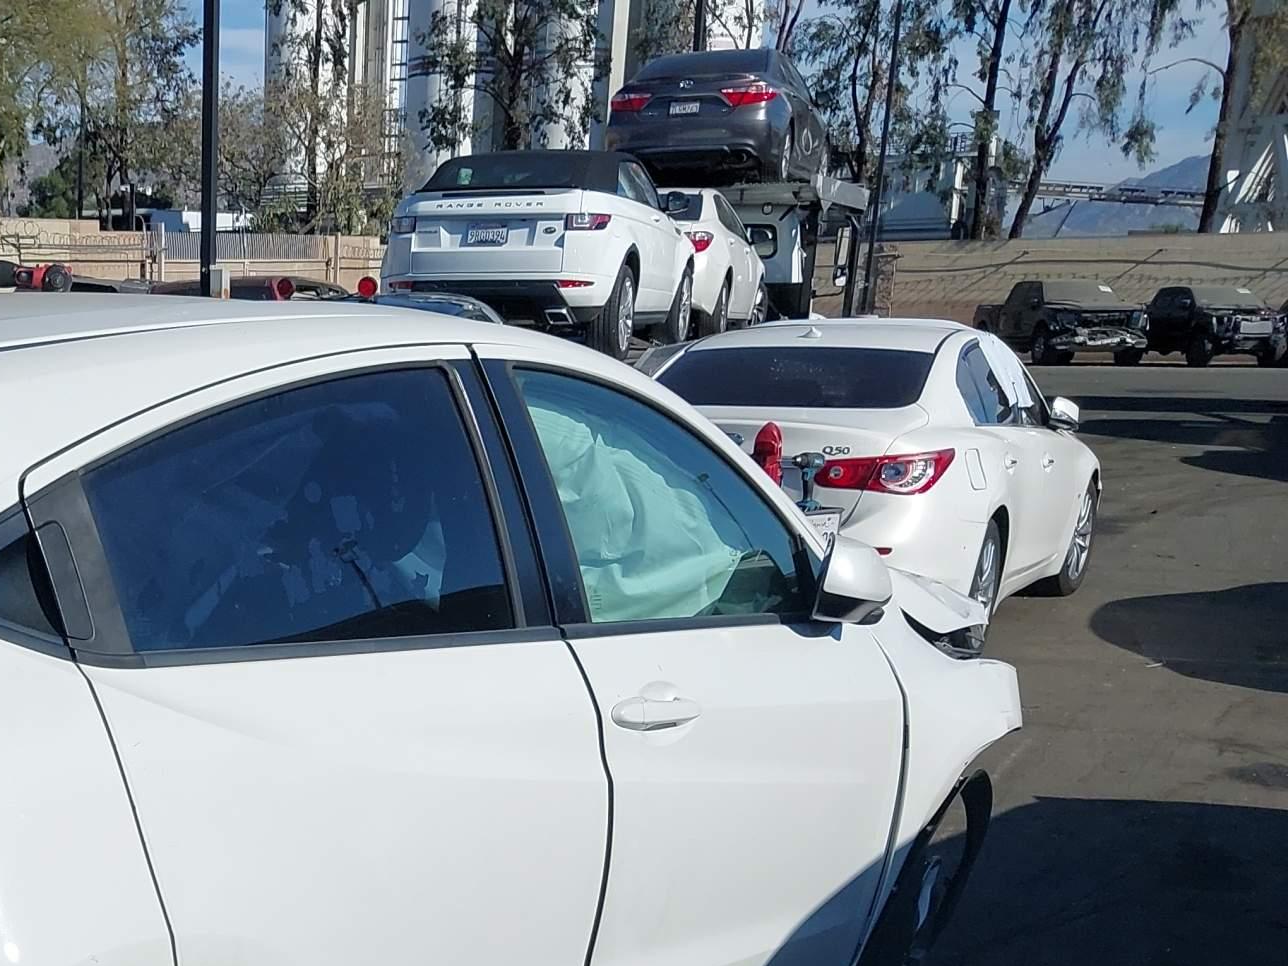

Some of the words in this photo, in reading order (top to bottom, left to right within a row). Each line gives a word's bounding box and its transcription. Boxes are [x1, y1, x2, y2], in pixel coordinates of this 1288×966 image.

[436, 202, 484, 210] RANGE
[494, 200, 545, 208] ROVER
[822, 445, 851, 456] Q50
